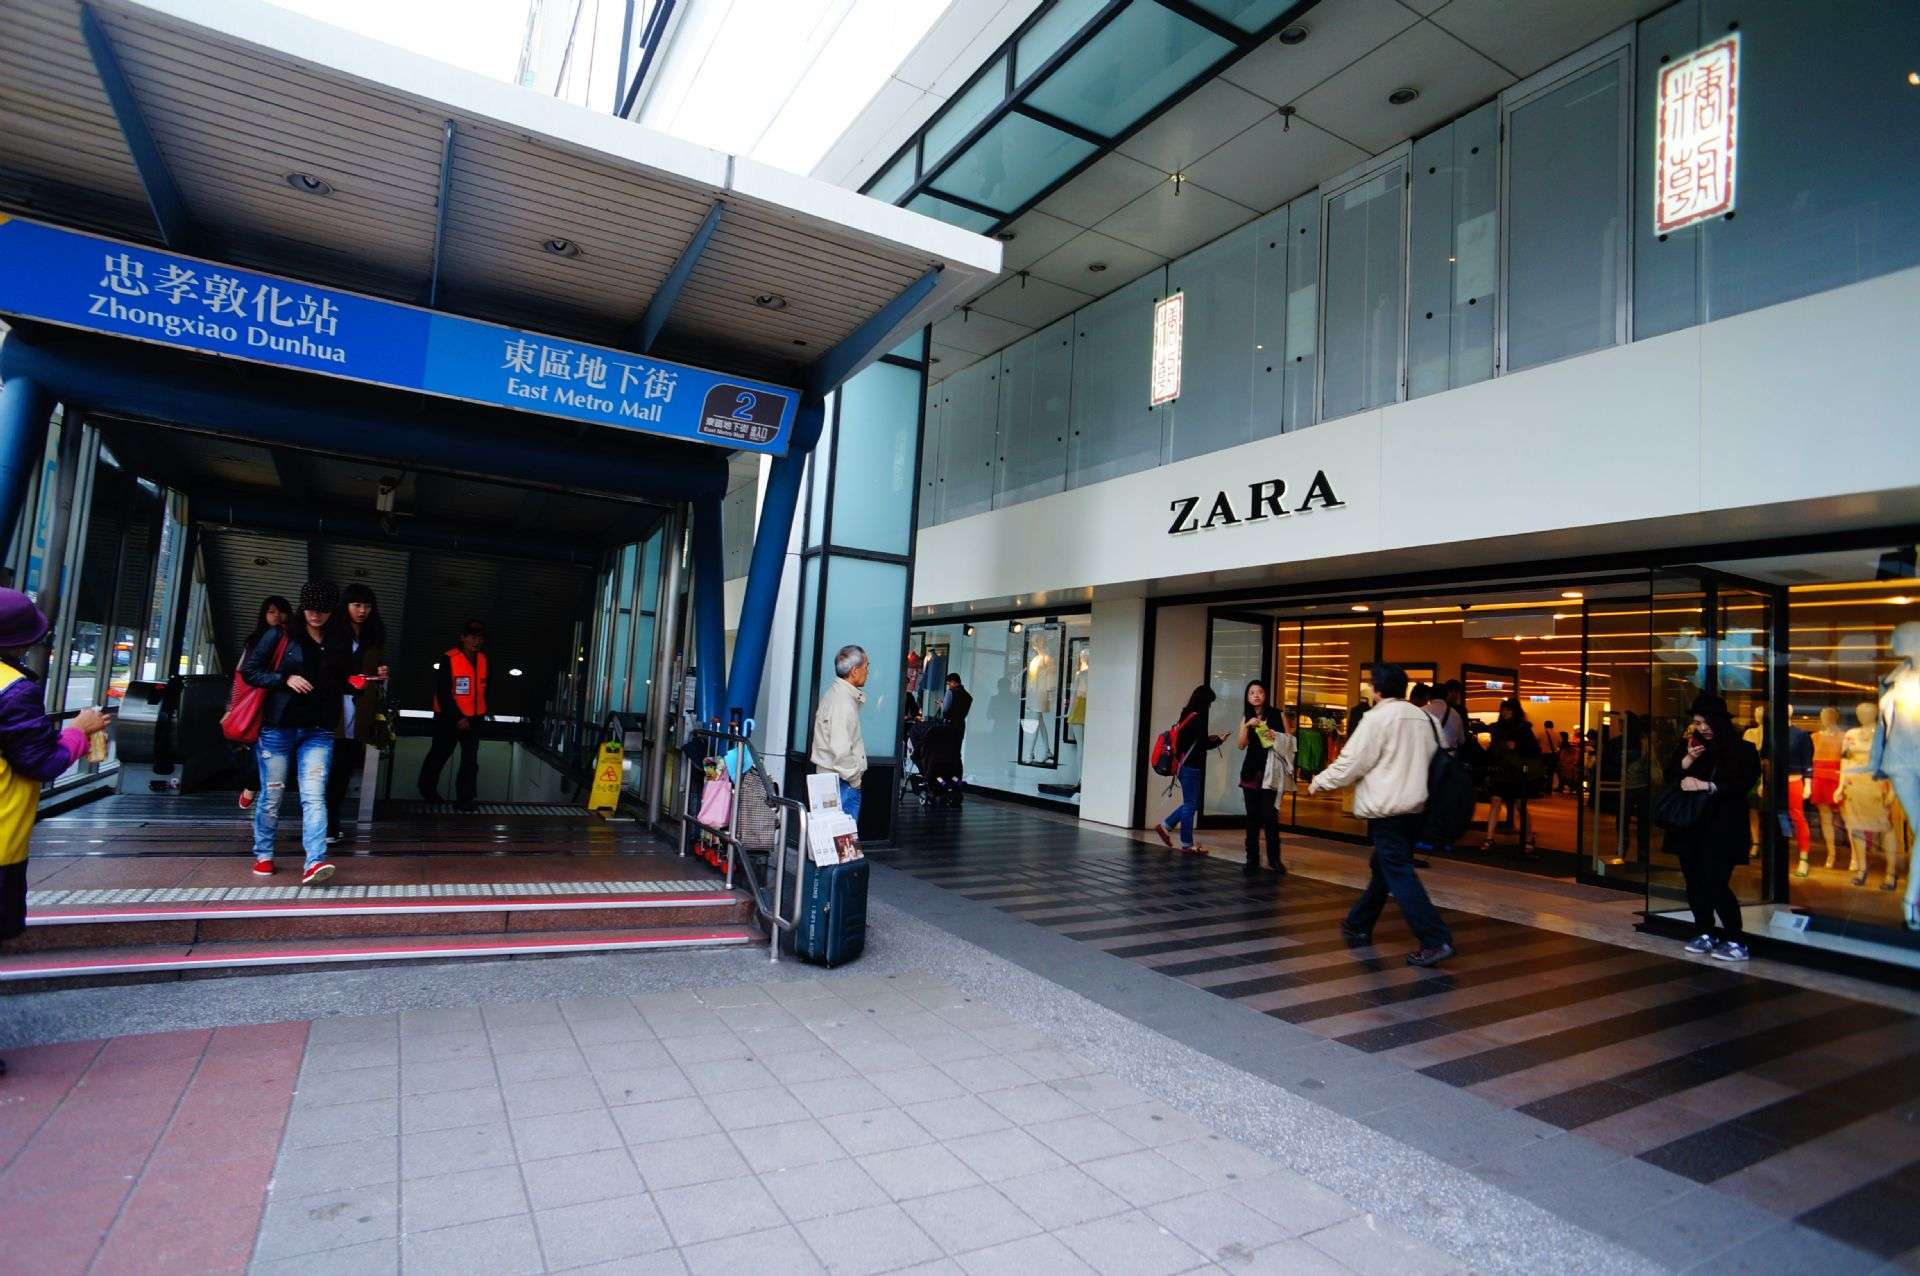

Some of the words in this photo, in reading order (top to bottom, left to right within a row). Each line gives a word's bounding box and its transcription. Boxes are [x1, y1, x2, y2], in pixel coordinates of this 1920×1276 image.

[99, 253, 340, 337] 忠孝敦化站
[87, 293, 239, 342] Zhongxiao
[247, 326, 347, 364] Dunhua
[501, 338, 679, 403] 東區地下街
[506, 377, 550, 401] East
[553, 386, 614, 413] Metro
[619, 399, 663, 422] Mall
[731, 391, 757, 421] 2
[1167, 470, 1346, 535] ZARA
